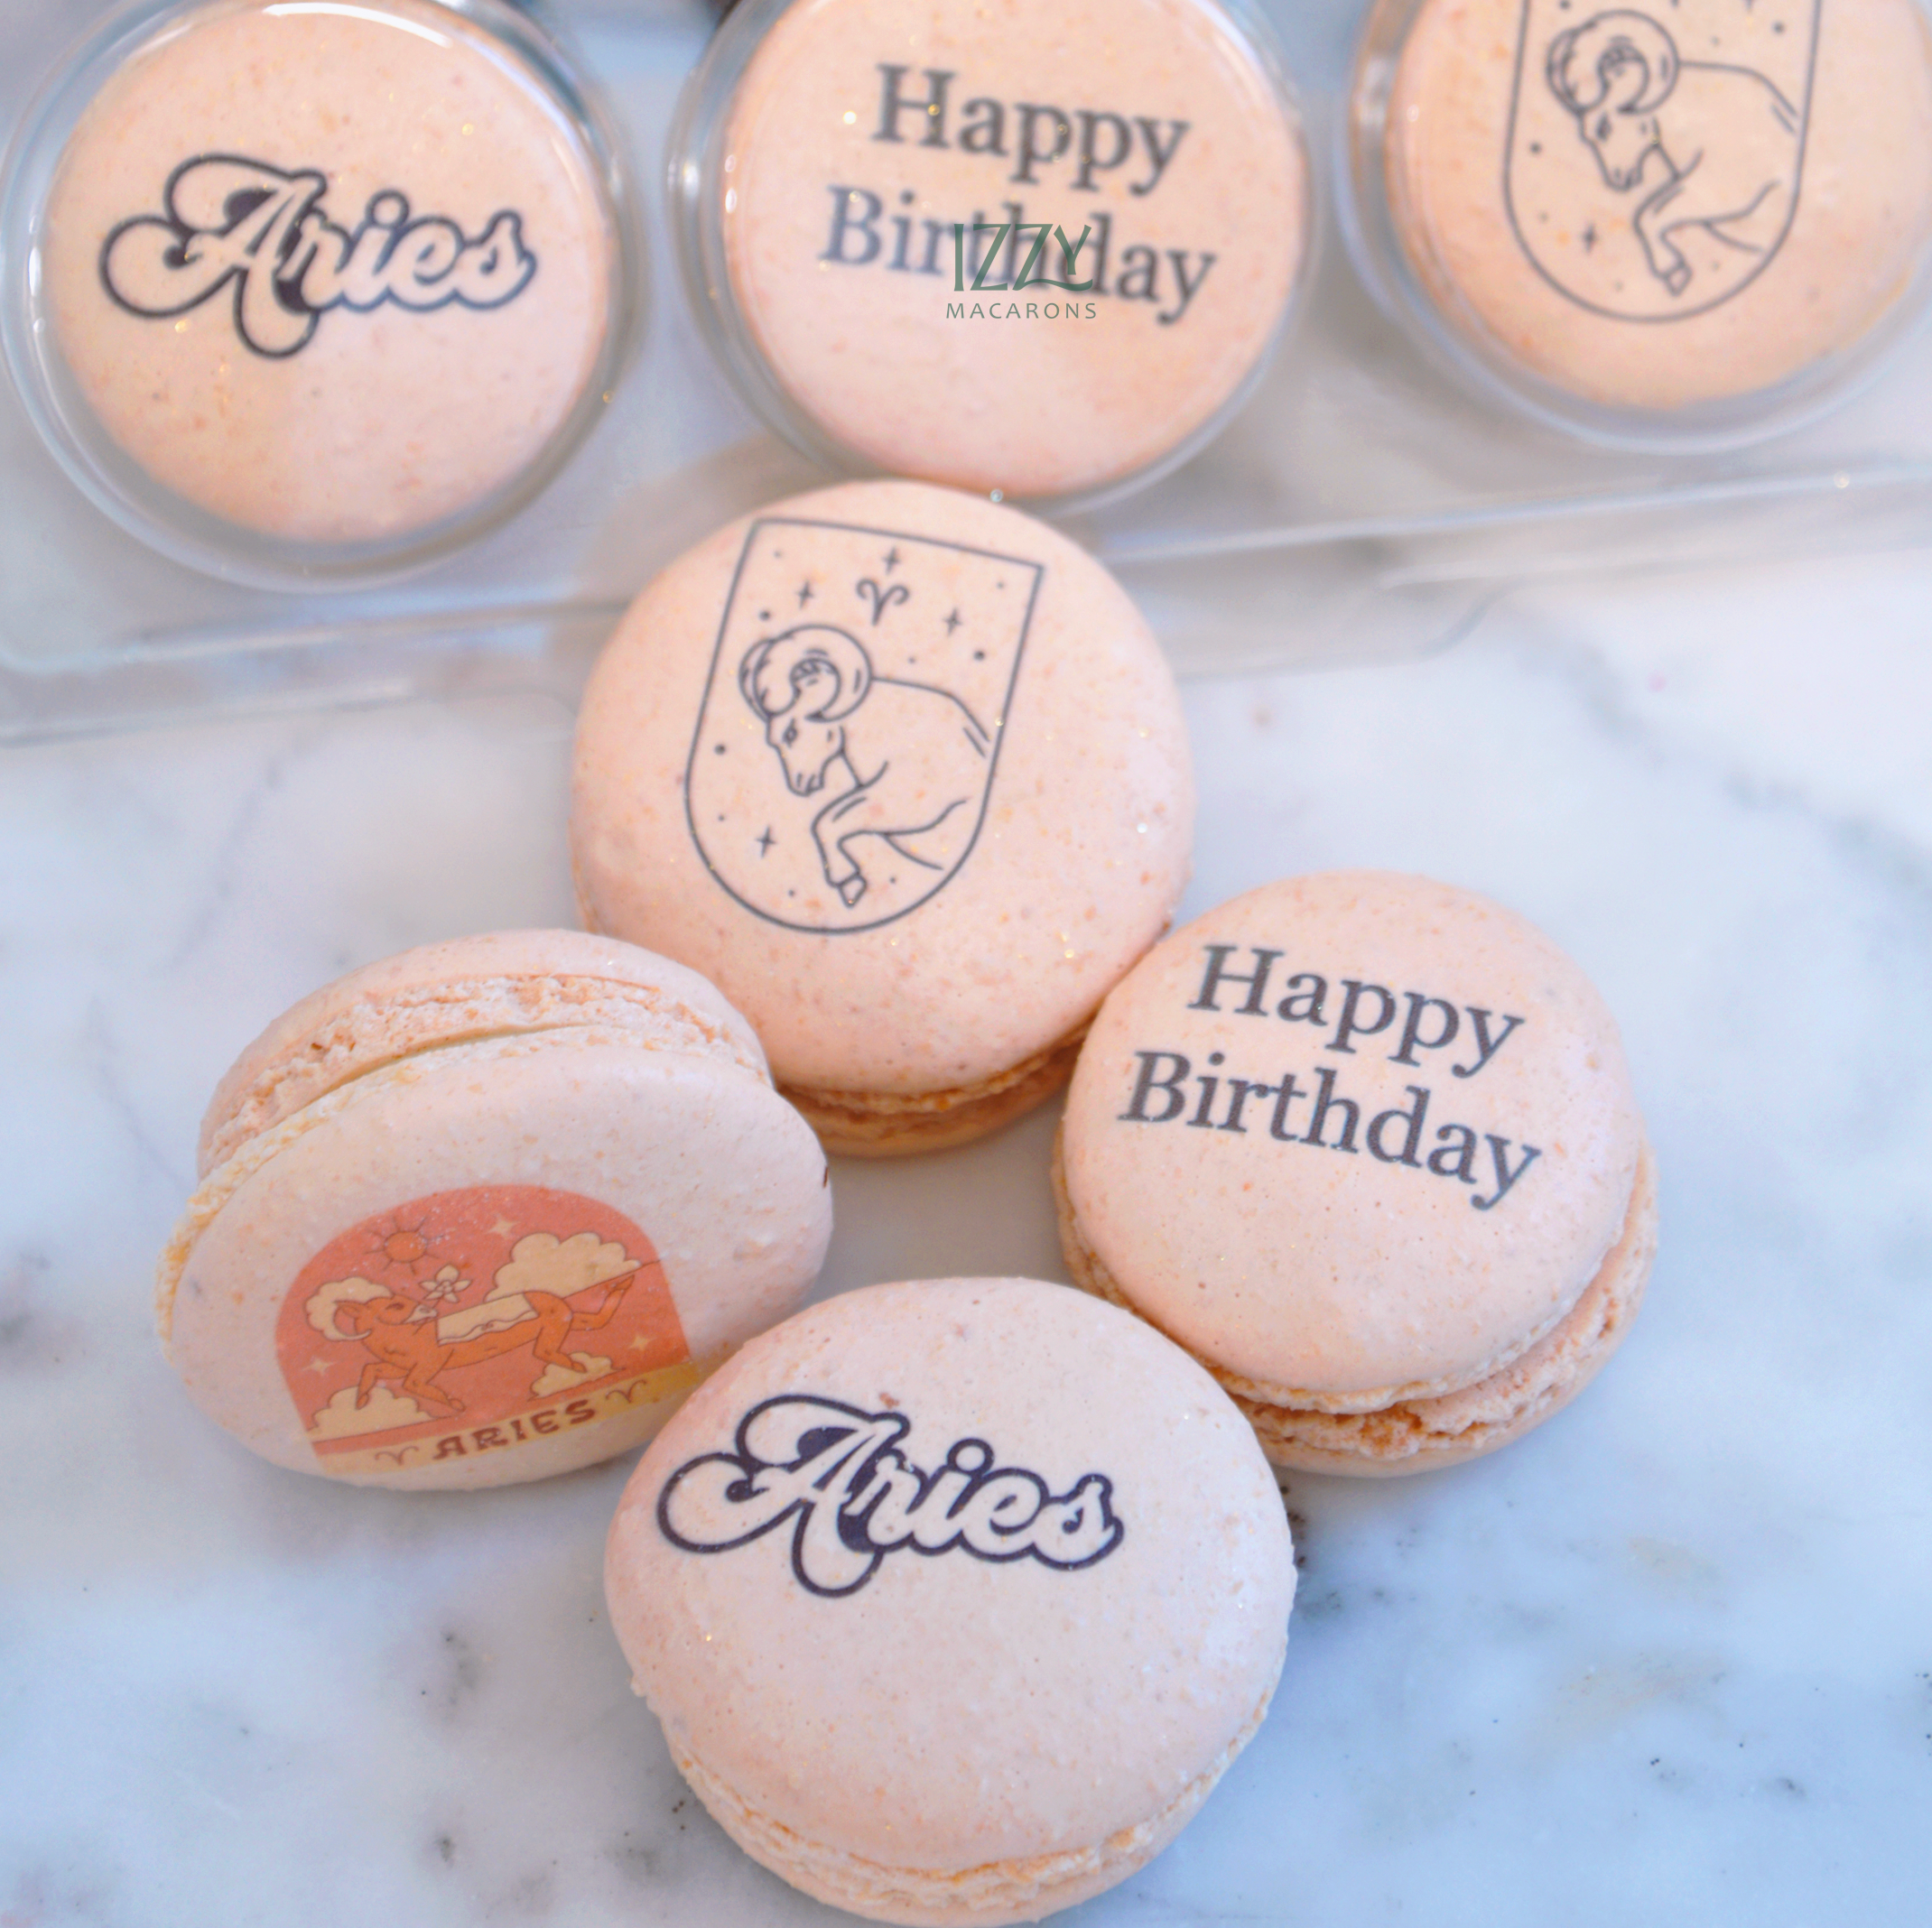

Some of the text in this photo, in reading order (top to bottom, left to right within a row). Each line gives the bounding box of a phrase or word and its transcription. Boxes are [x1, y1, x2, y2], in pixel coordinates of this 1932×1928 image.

[870, 62, 1191, 196] Happy
[99, 152, 537, 359] Aries
[818, 184, 1218, 326] Birthday
[1186, 944, 1525, 1079] Happy
[1117, 1050, 1542, 1211] Birthday
[432, 1399, 597, 1460] ARIES
[656, 1394, 1125, 1599] Aries
